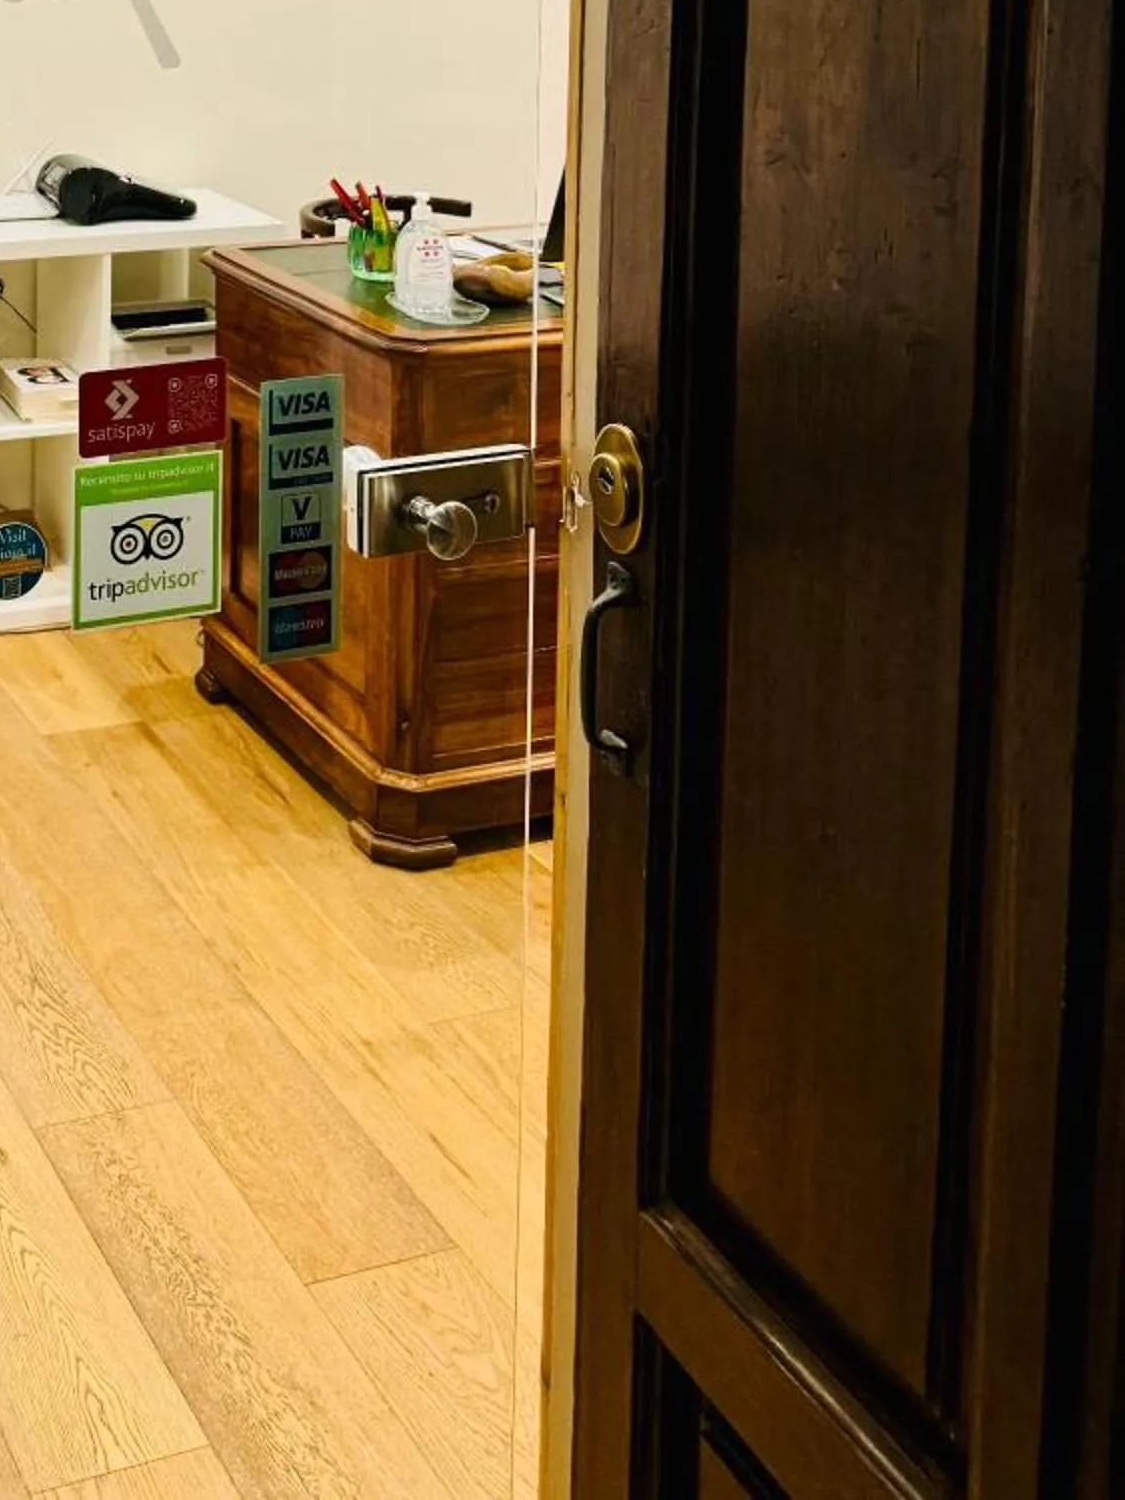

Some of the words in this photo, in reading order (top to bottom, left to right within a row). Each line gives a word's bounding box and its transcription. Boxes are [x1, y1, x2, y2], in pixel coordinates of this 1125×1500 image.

[278, 390, 331, 417] VISA
[87, 421, 156, 444] satispay
[278, 445, 331, 471] VISA
[290, 525, 312, 539] PAY
[89, 569, 200, 603] tripadvisor
